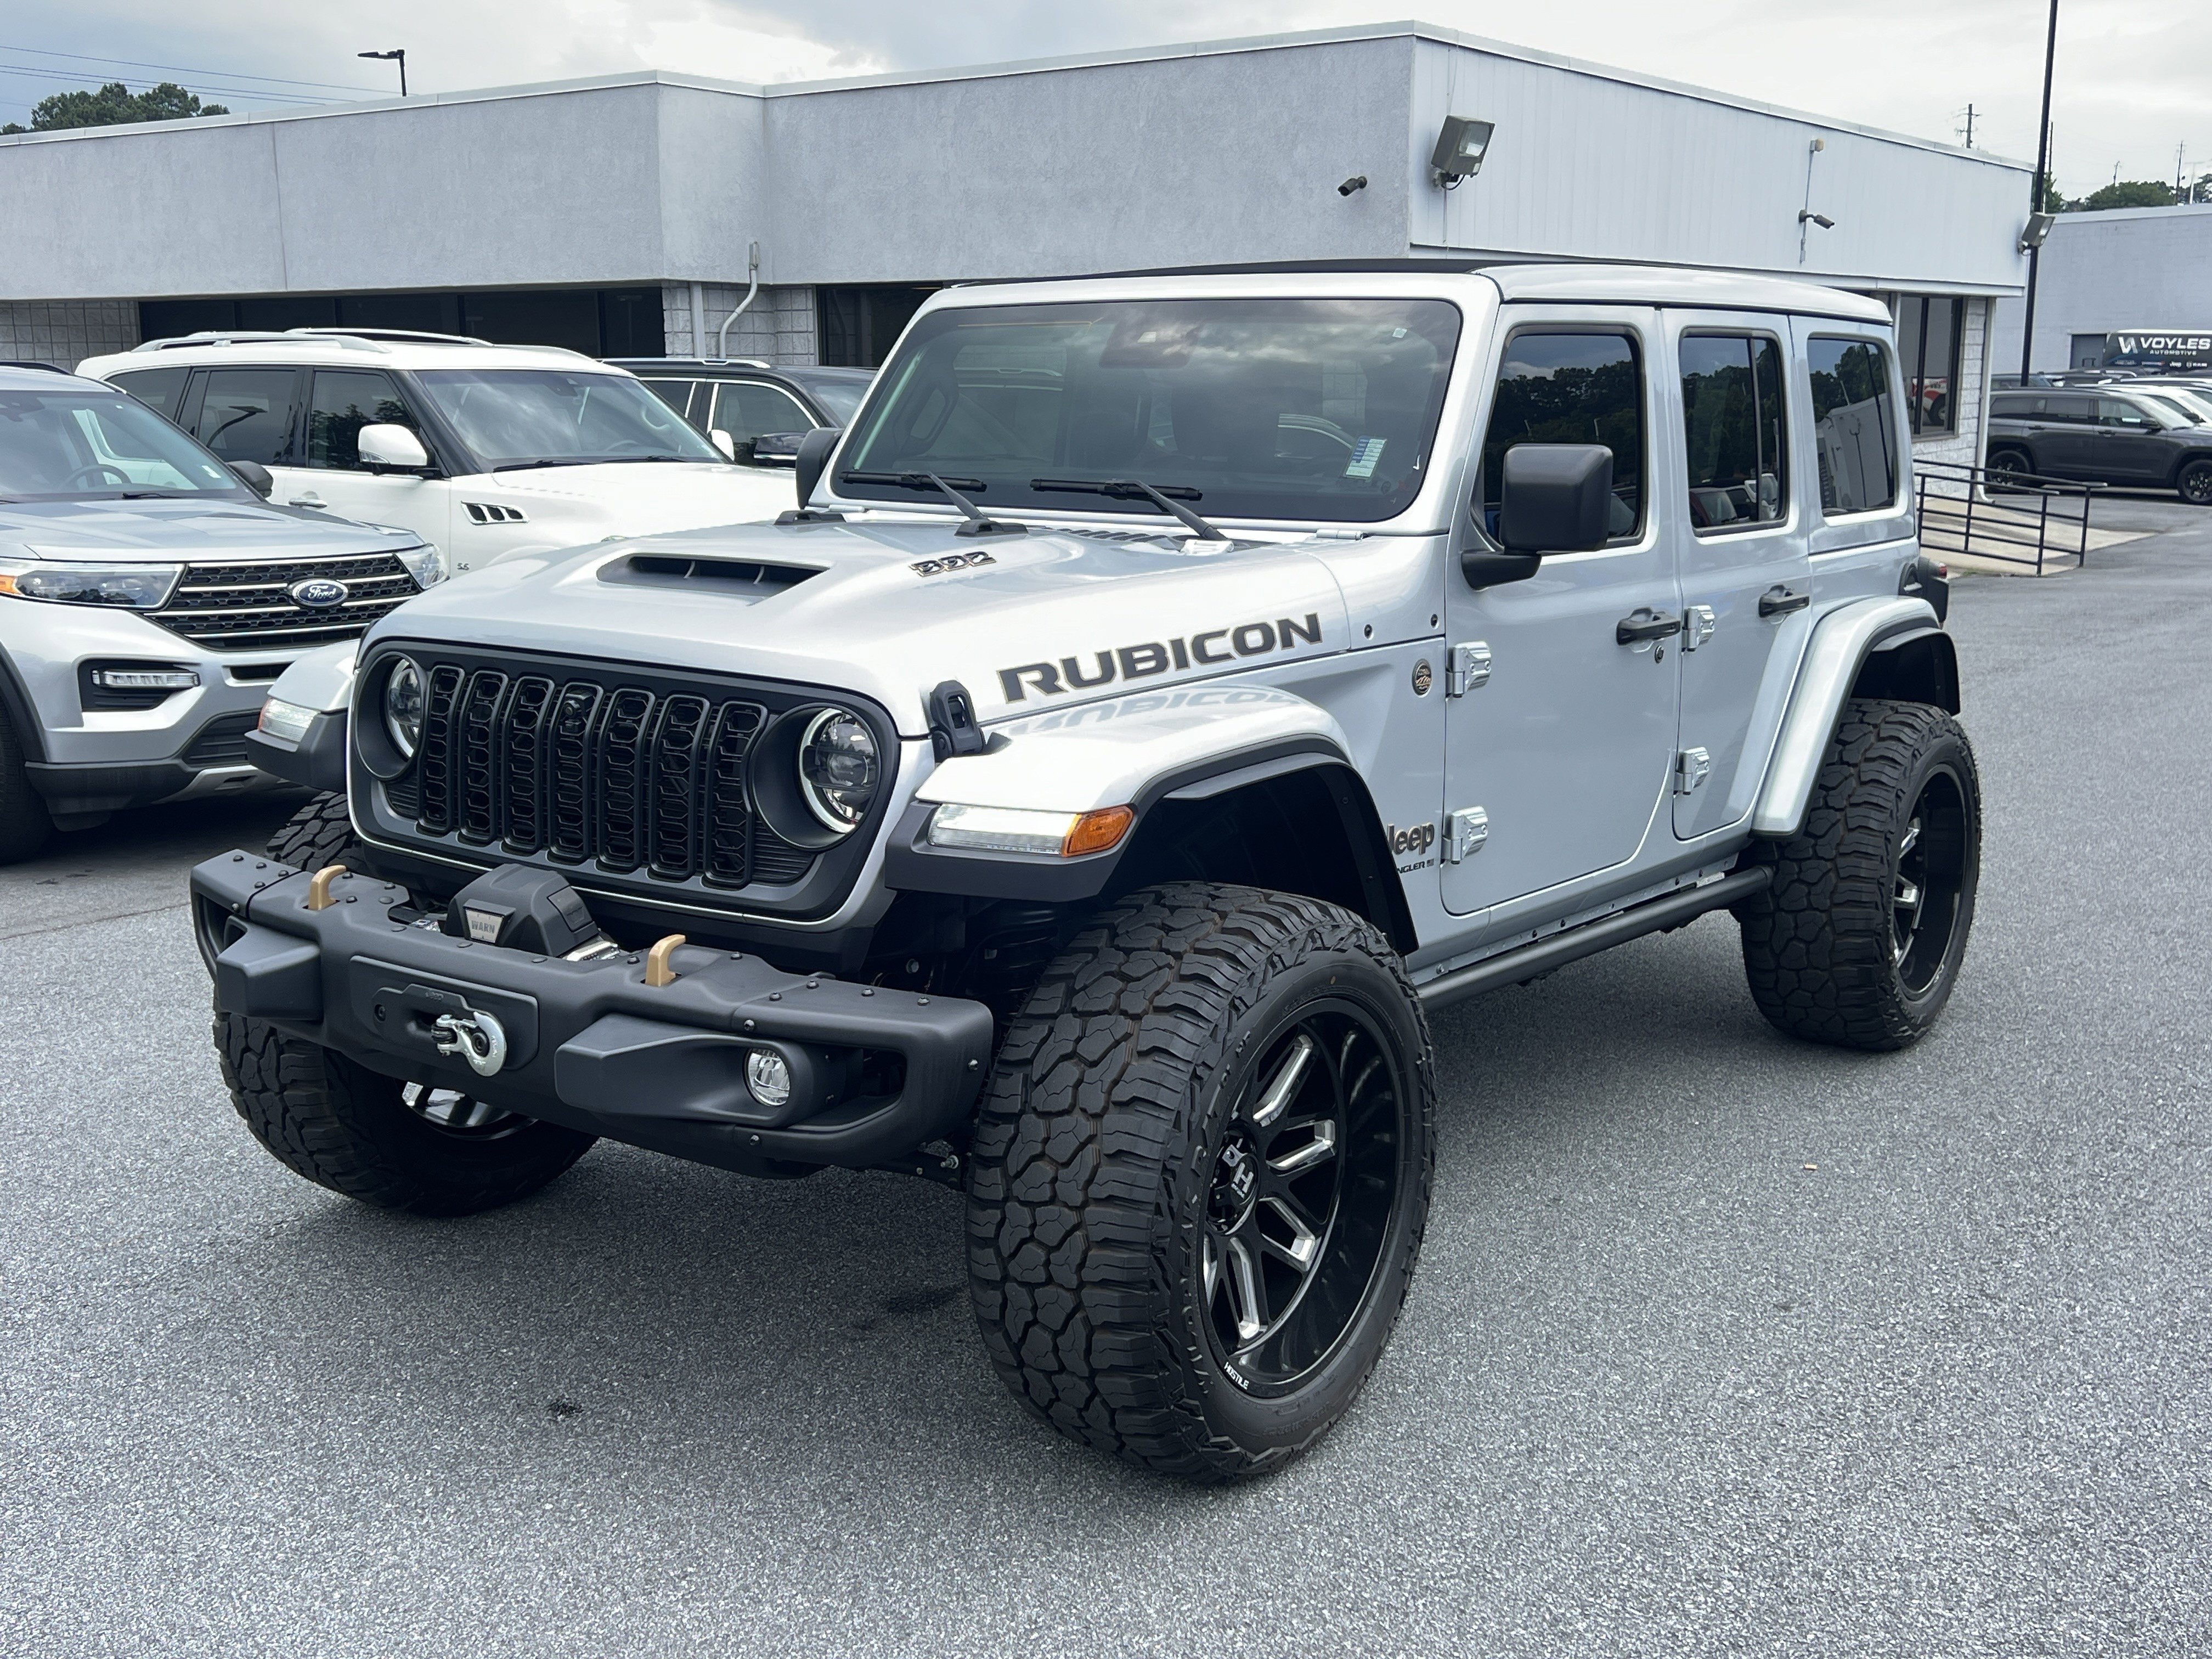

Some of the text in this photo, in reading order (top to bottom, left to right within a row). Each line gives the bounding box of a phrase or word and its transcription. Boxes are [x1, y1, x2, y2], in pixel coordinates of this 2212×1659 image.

[2140, 337, 2211, 350] VOYLES
[908, 551, 997, 577] 392
[308, 585, 336, 599] Ford
[996, 612, 1323, 704] RUBICON
[1387, 822, 1435, 855] Jeep
[1397, 861, 1425, 873] NGLER
[471, 921, 495, 934] WARN
[1224, 1362, 1250, 1390] HOSTILE
